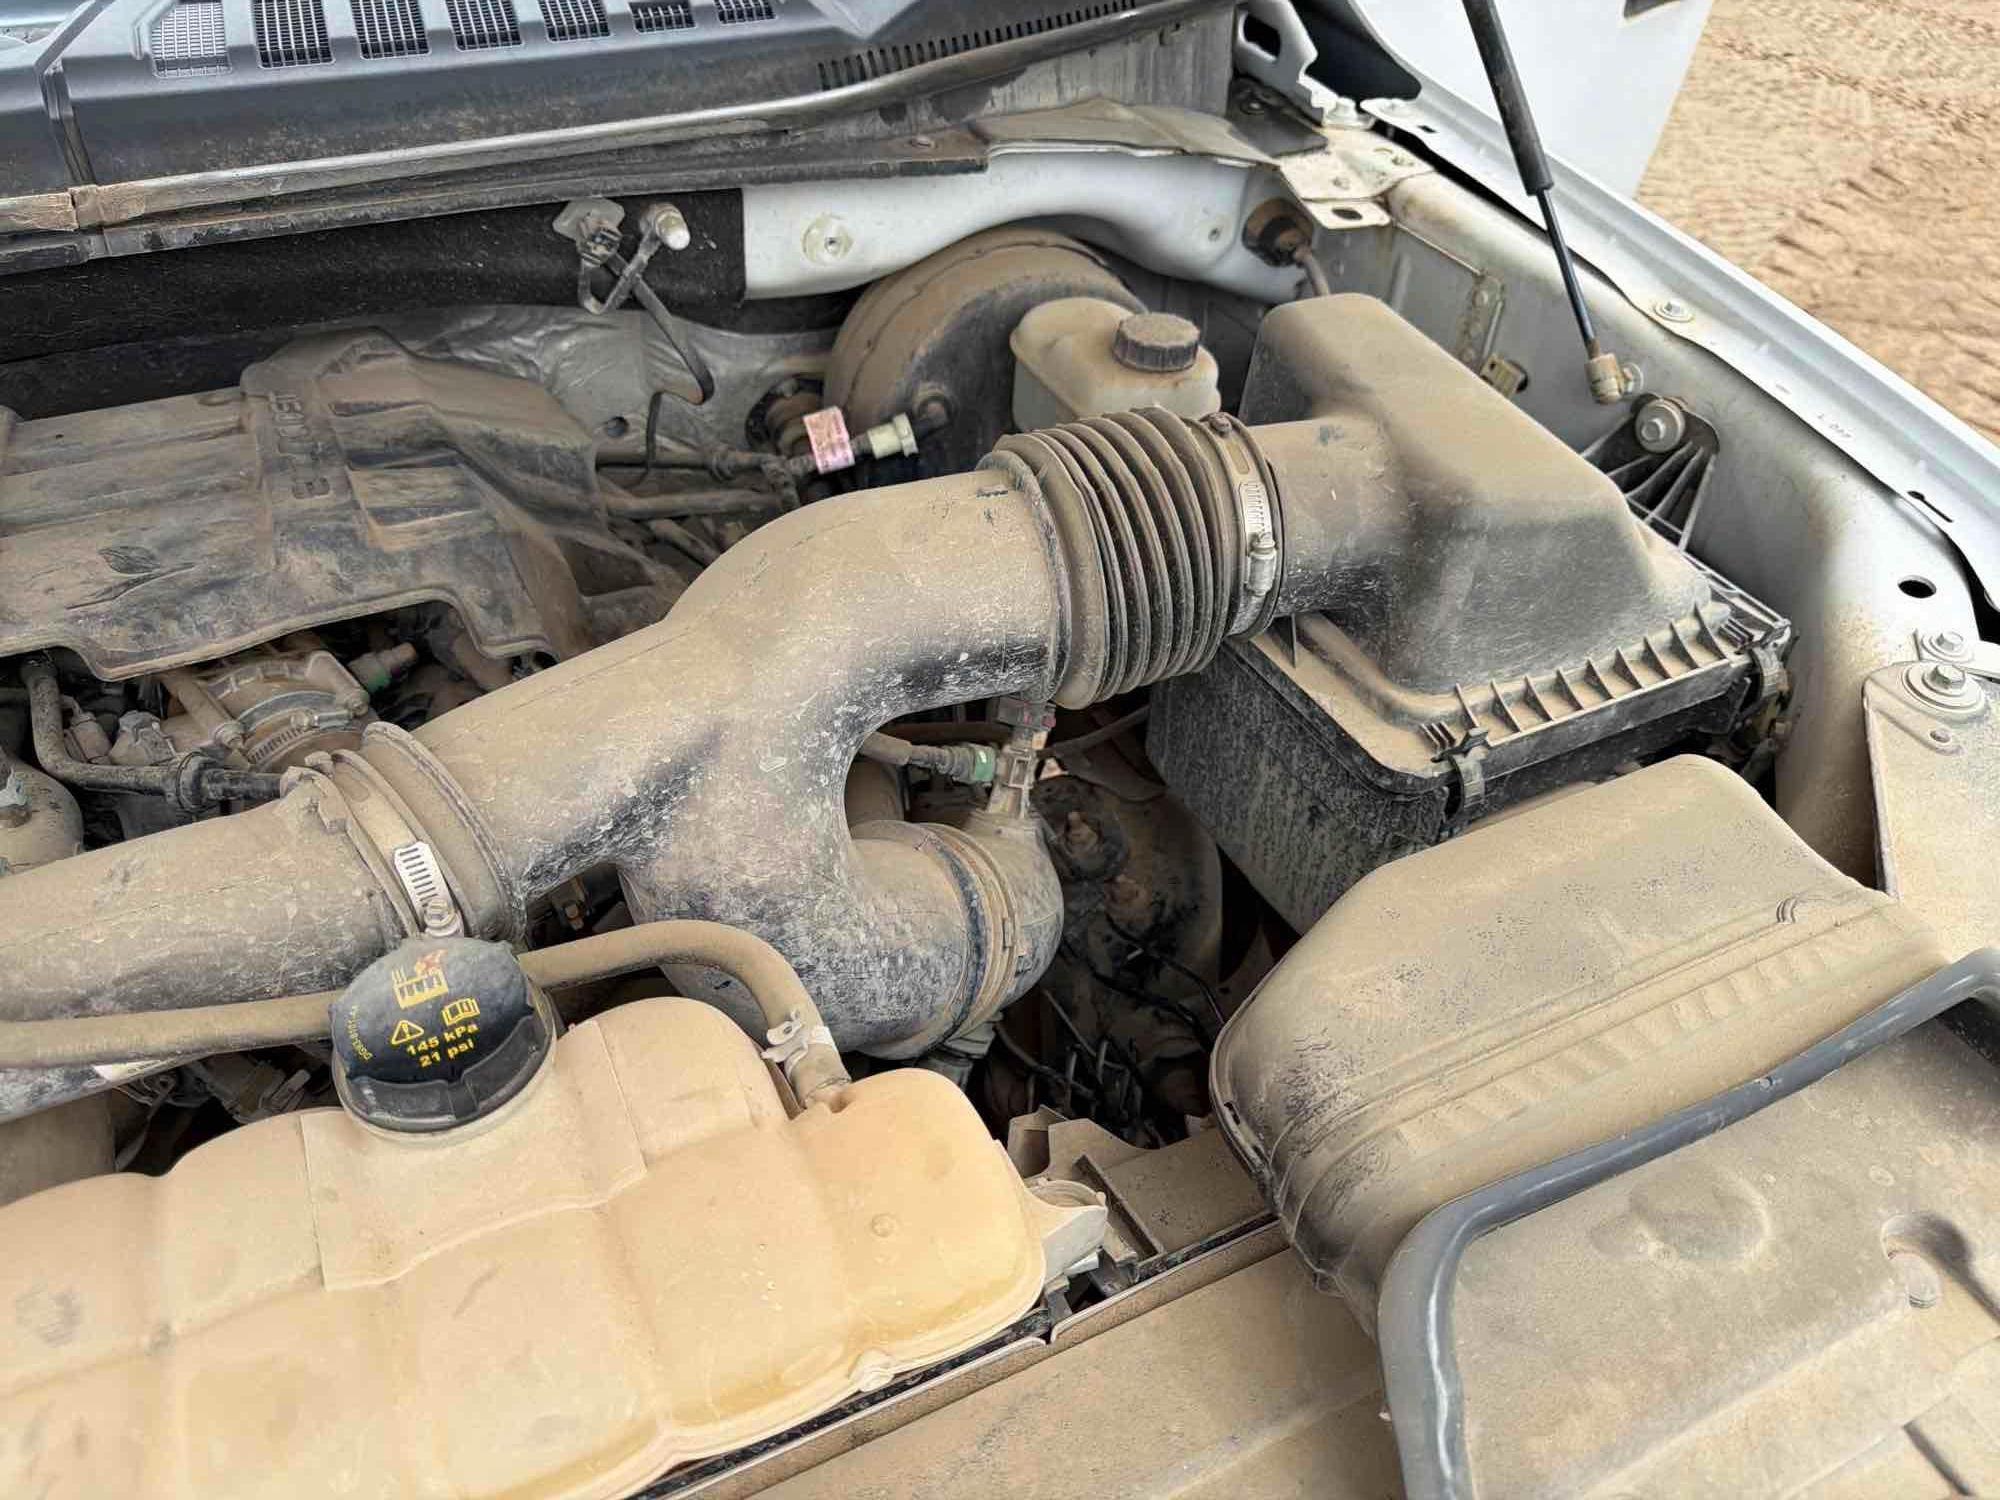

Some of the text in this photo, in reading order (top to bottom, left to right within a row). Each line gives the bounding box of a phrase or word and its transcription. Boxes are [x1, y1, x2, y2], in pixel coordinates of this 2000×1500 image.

[407, 1023, 479, 1055] 145 kPa
[419, 1038, 474, 1068] 21 psi
